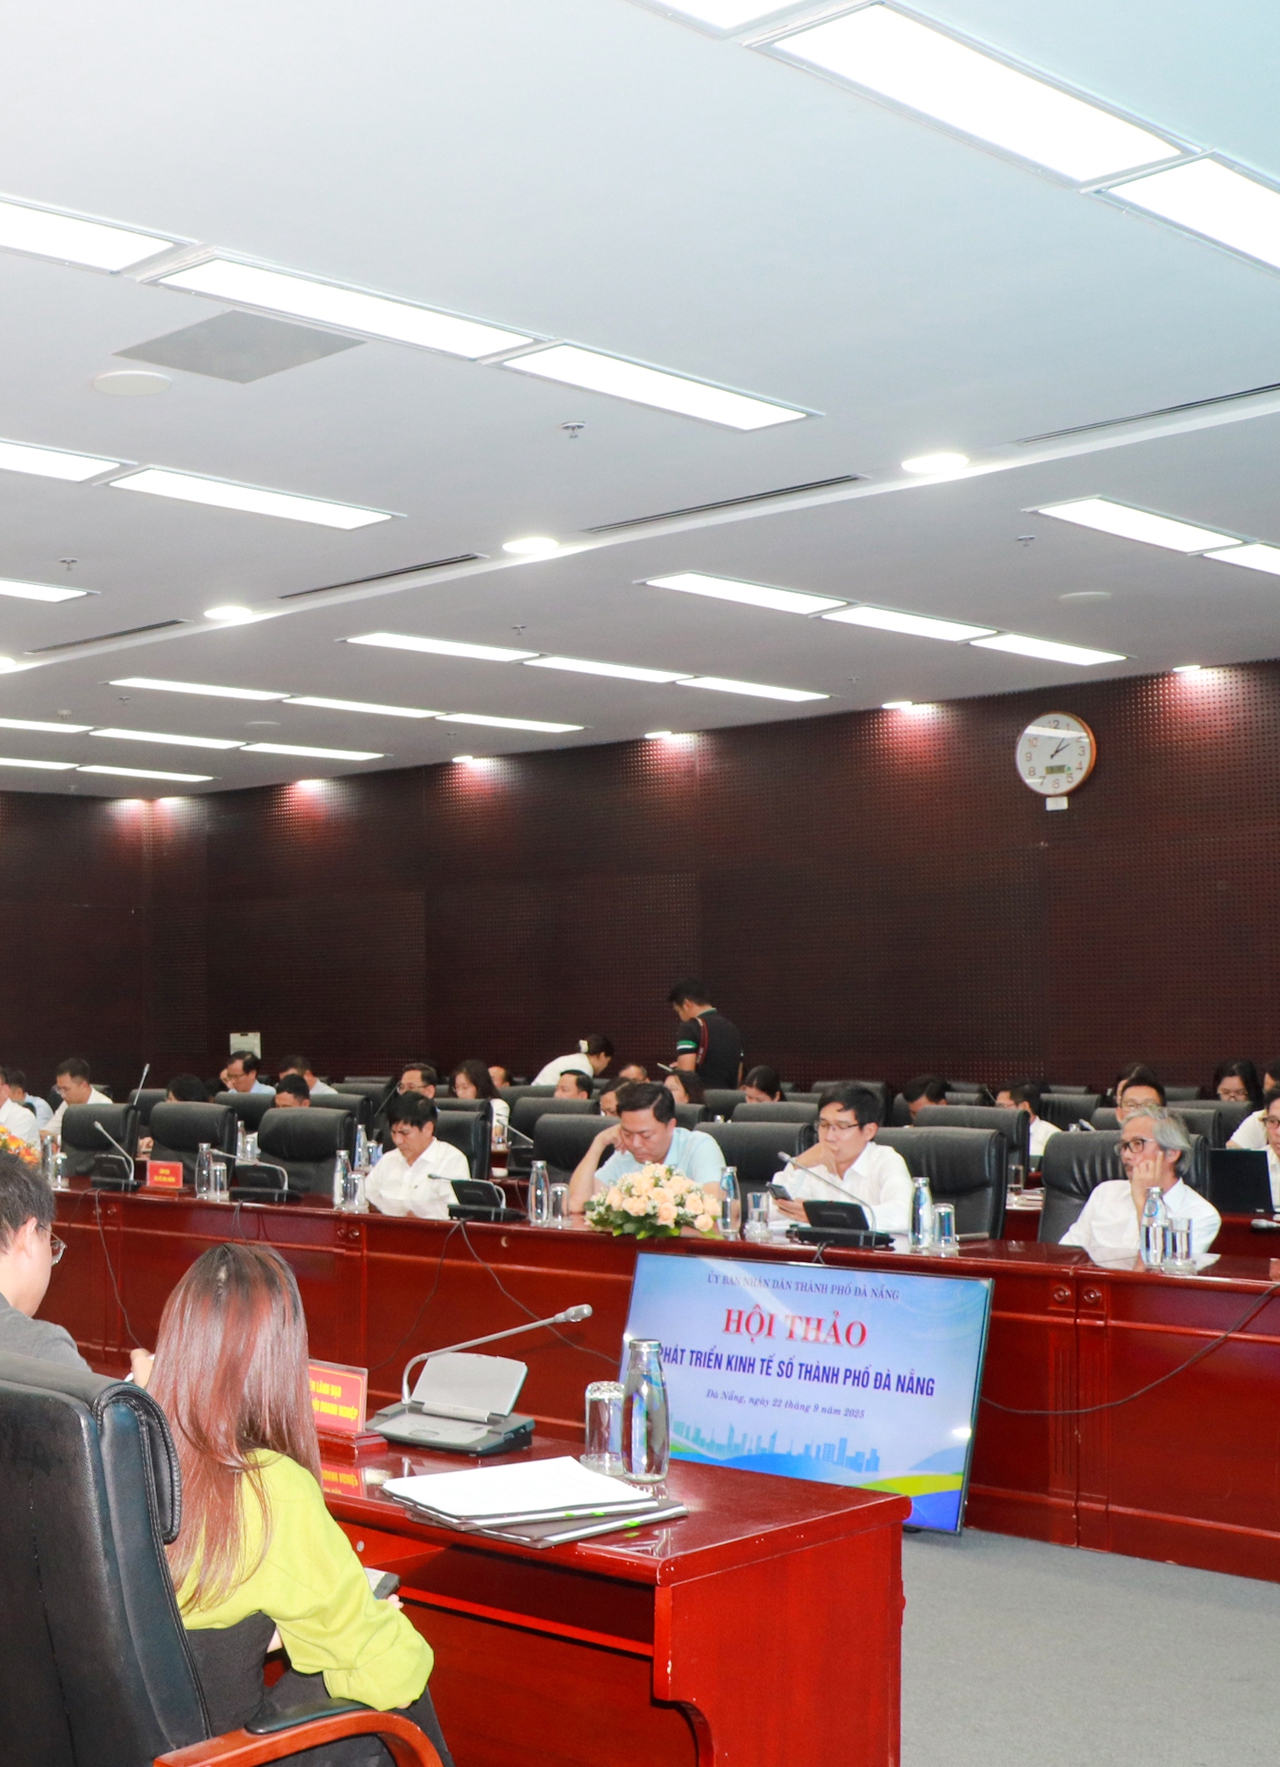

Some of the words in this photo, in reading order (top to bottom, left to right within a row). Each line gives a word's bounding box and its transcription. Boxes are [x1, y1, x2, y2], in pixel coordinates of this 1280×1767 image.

[1025, 751, 1033, 762] 9
[1078, 746, 1086, 756] 3
[1028, 766, 1036, 776] 8
[1076, 760, 1083, 771] 4
[1039, 775, 1046, 786] 7
[1066, 773, 1074, 783] 5
[1052, 779, 1060, 789] 6
[707, 1270, 721, 1284] ỦY
[722, 1273, 741, 1286] BAN
[772, 1277, 792, 1291] DÂN
[795, 1279, 828, 1294] THÀNH
[831, 1281, 853, 1296] PHỐ
[723, 1303, 778, 1342] HỘI
[785, 1310, 867, 1347] THẢO
[689, 1345, 723, 1371] TRIỂN
[725, 1354, 756, 1375] KINH
[760, 1353, 775, 1376] TẾ
[776, 1355, 795, 1379] SỐ
[798, 1361, 840, 1385] THÀNH
[843, 1364, 872, 1389] PHỐ
[873, 1369, 891, 1391] ĐÀ
[895, 1369, 935, 1397] NẴNG
[772, 1398, 783, 1407] 22
[813, 1403, 819, 1413] 9
